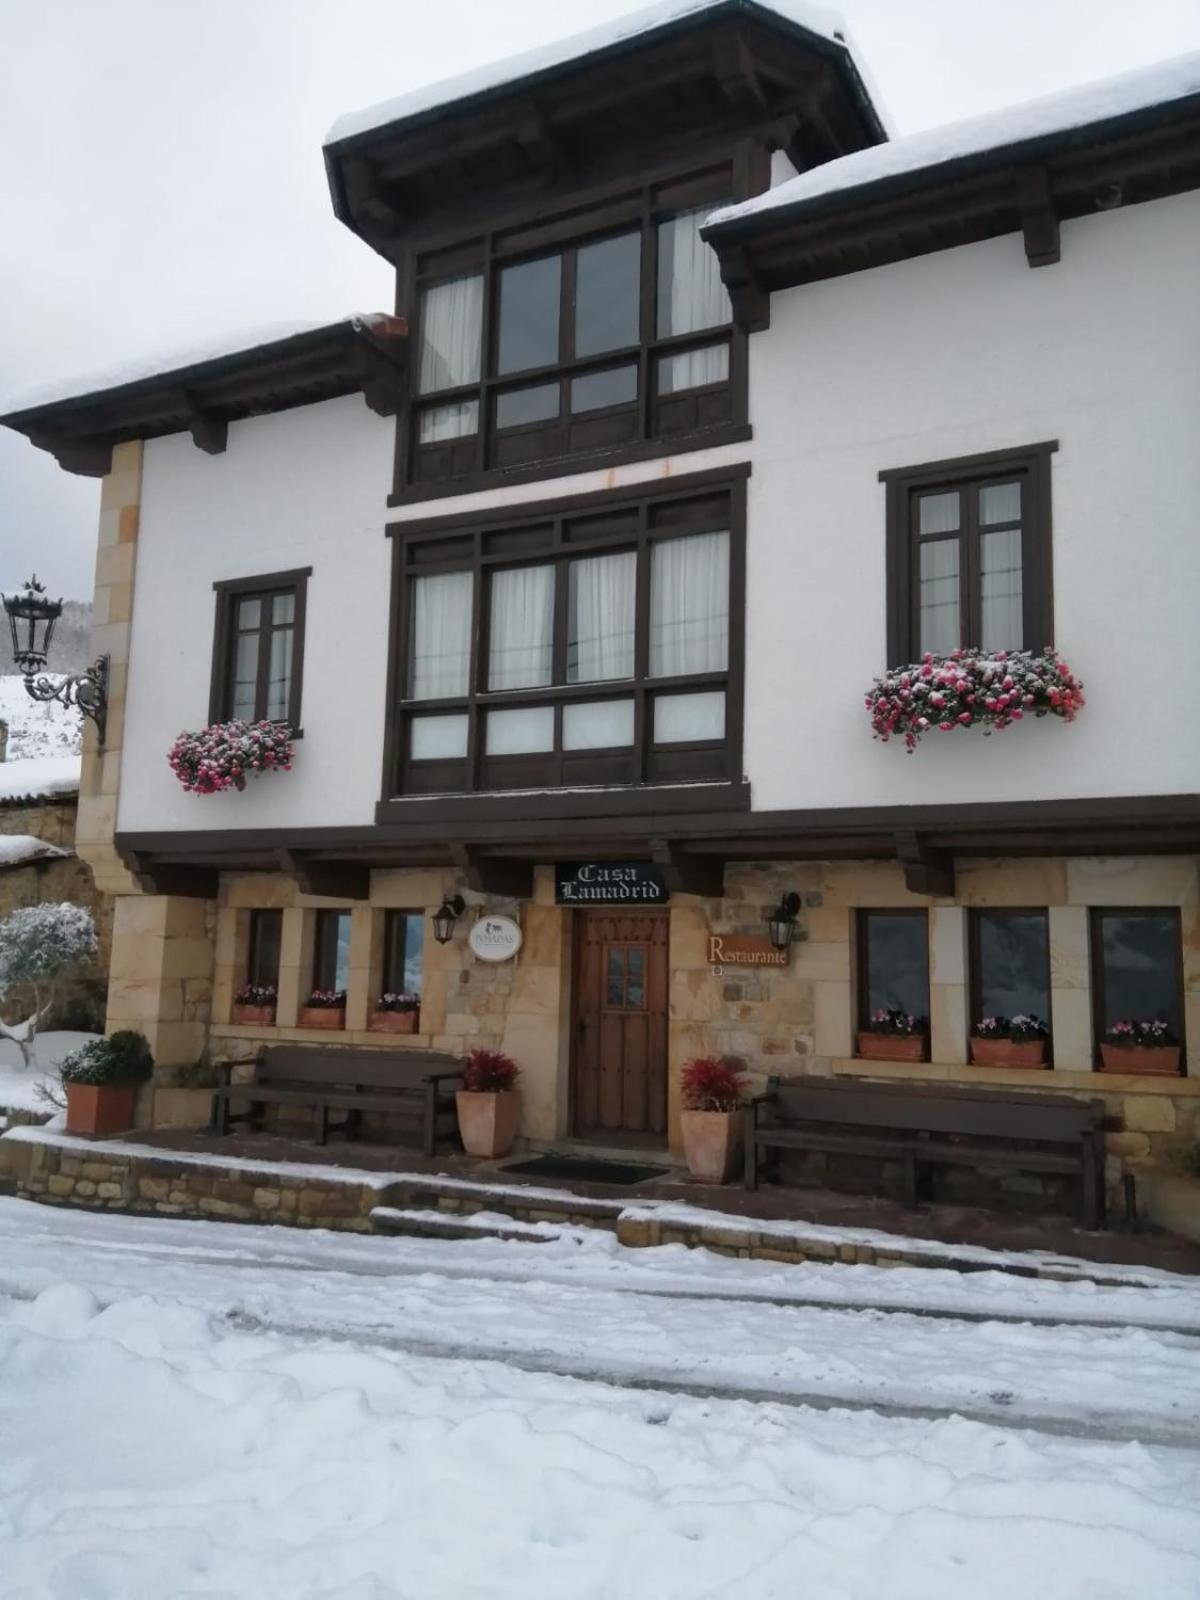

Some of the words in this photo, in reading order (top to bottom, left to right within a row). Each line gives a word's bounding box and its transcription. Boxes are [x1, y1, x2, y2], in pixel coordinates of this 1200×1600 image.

[578, 865, 637, 882] Casa
[560, 881, 660, 899] Lamadrid
[709, 936, 786, 963] Restaurante
